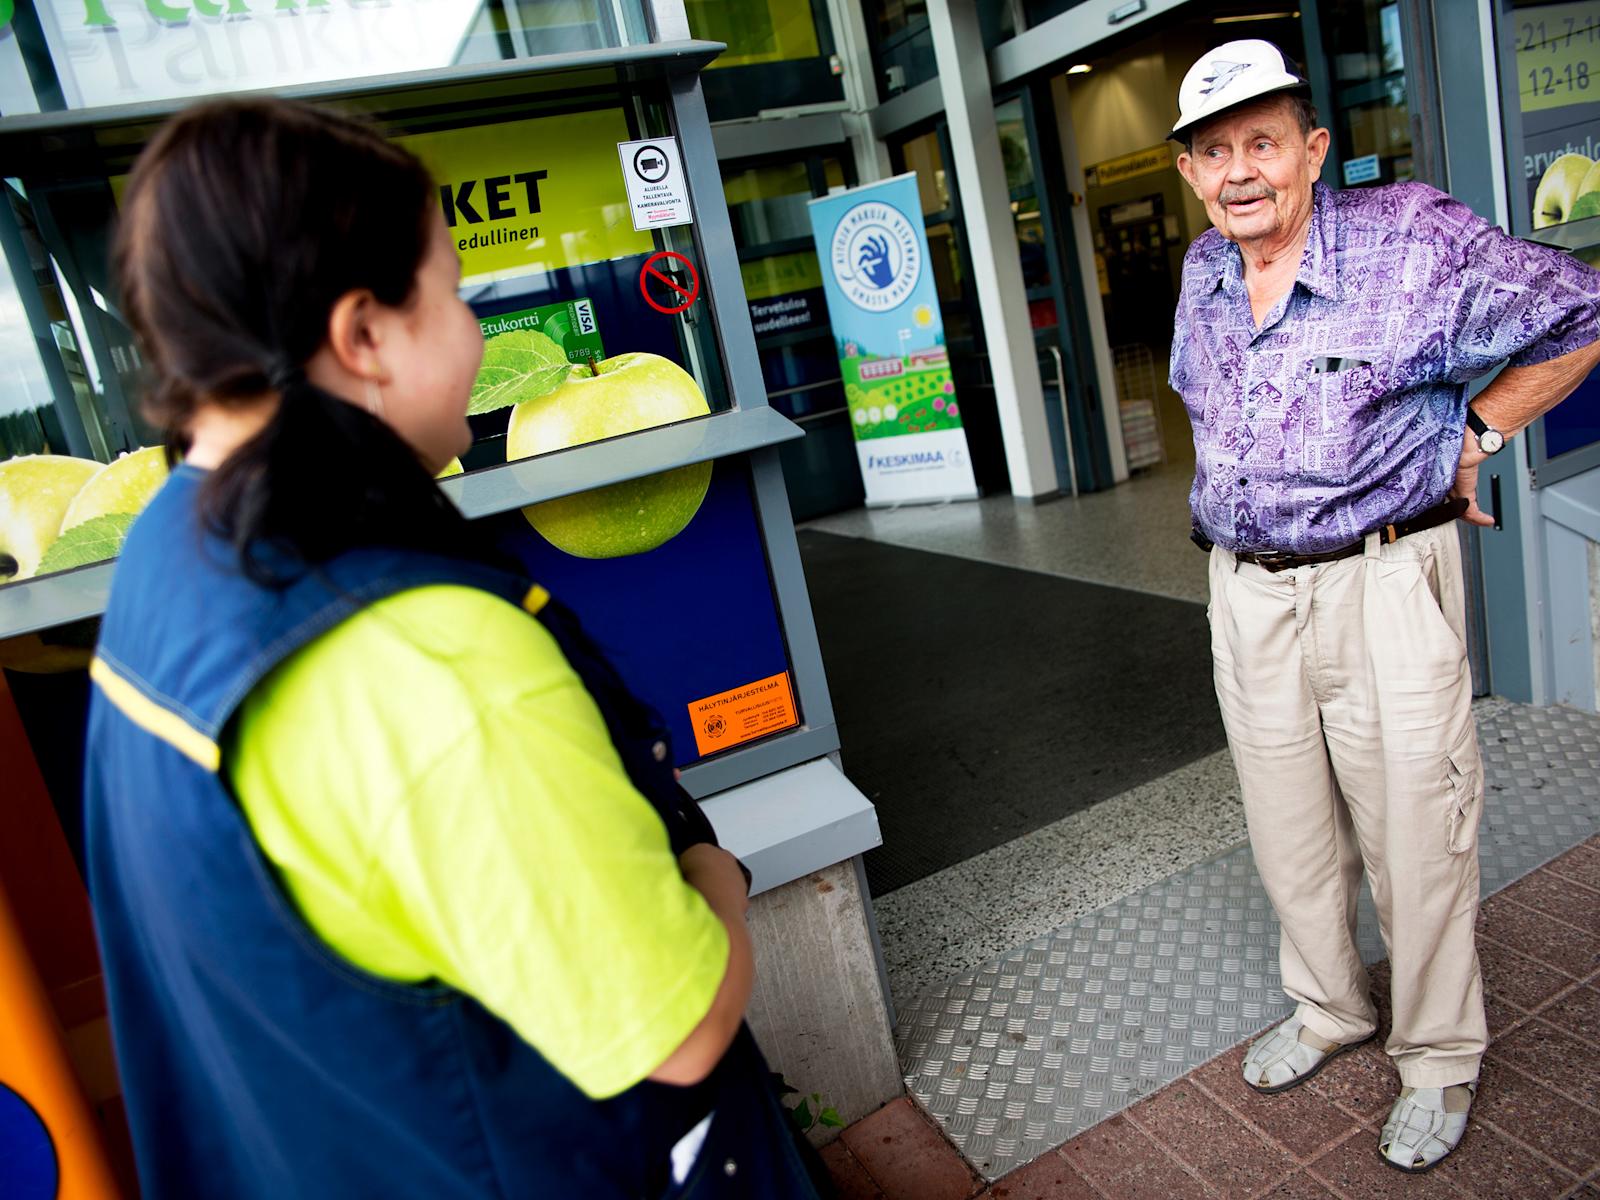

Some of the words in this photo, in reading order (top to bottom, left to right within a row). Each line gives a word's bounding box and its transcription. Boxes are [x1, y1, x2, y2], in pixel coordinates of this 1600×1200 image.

[1562, 16, 1600, 48] 7-1
[1528, 61, 1590, 96] 12-18
[637, 199, 681, 208] KAMERAVALVONTA
[643, 192, 673, 200] TALLENTAVA
[850, 208, 888, 224] MAKUJA
[458, 226, 539, 251] edullinen
[578, 302, 593, 333] VISA
[750, 297, 808, 317] Tervetuloa
[480, 312, 540, 336] Etukortti
[754, 310, 811, 333] uudelleen!
[876, 450, 944, 468] KESKIMAA
